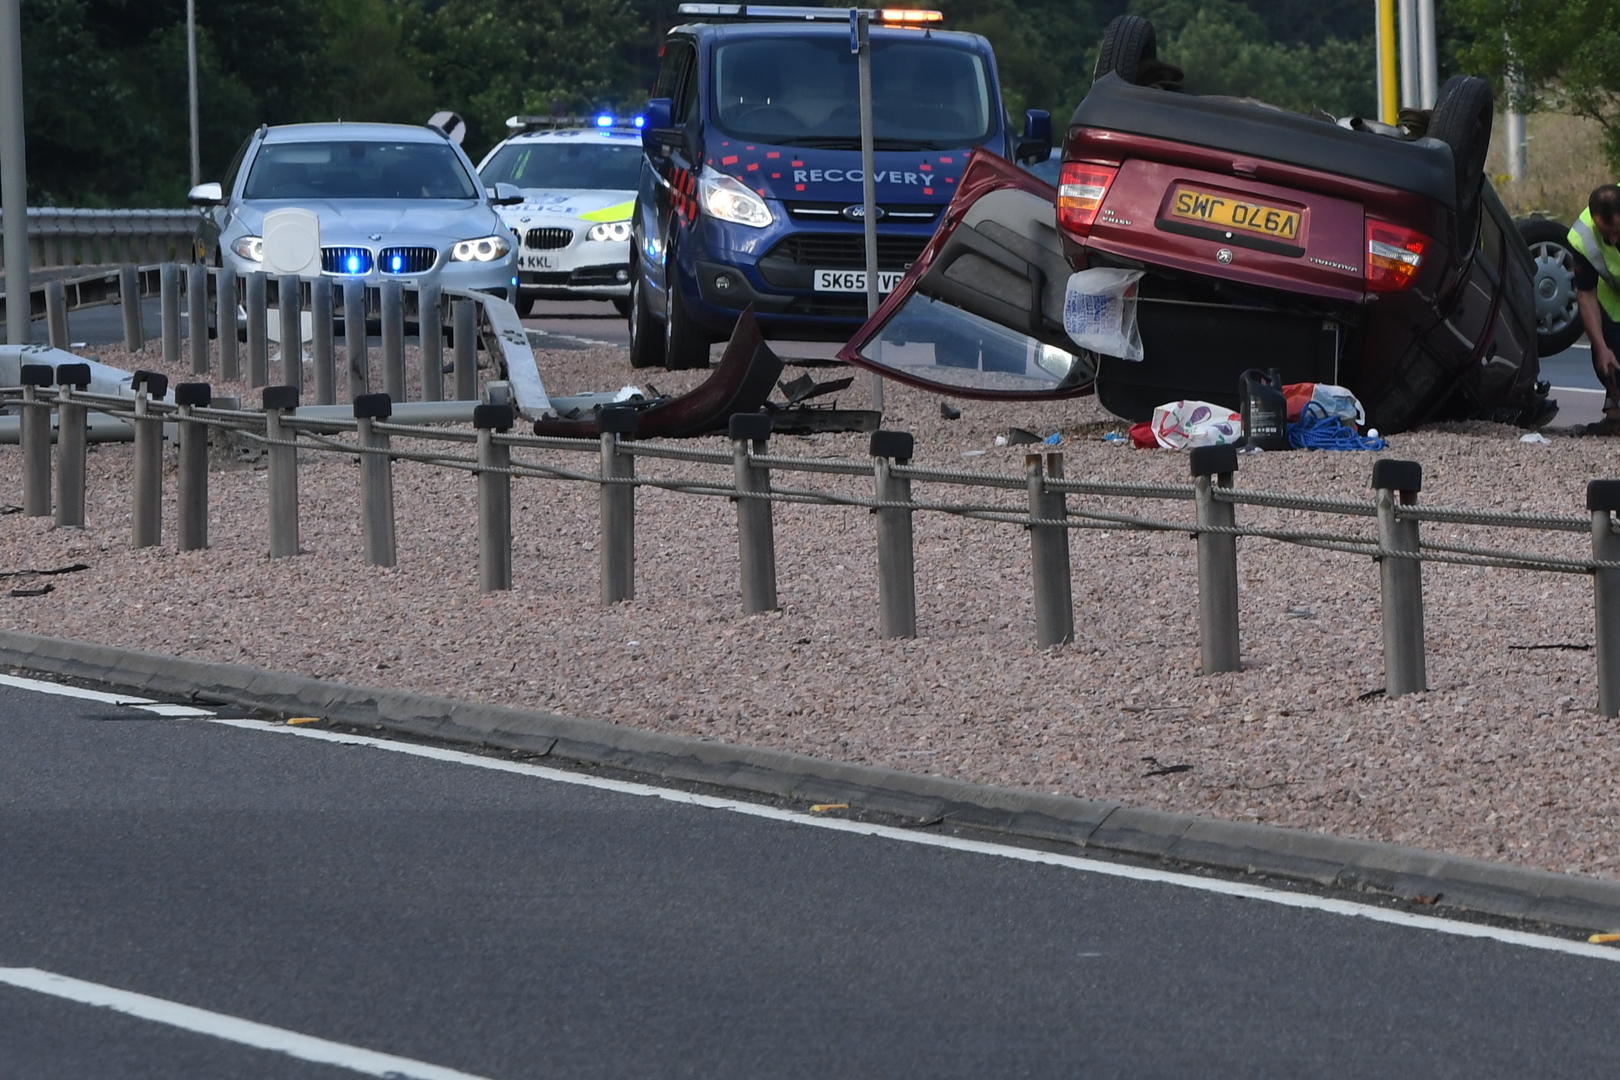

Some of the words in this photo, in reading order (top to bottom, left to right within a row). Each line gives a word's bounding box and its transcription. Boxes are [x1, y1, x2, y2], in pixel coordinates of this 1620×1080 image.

[793, 169, 935, 187] RECOVERY
[1176, 193, 1226, 218] JMS
[1231, 204, 1295, 235] V970
[527, 256, 552, 268] KKL
[1308, 256, 1358, 273] VAUXHALL
[821, 273, 866, 290] SK65
